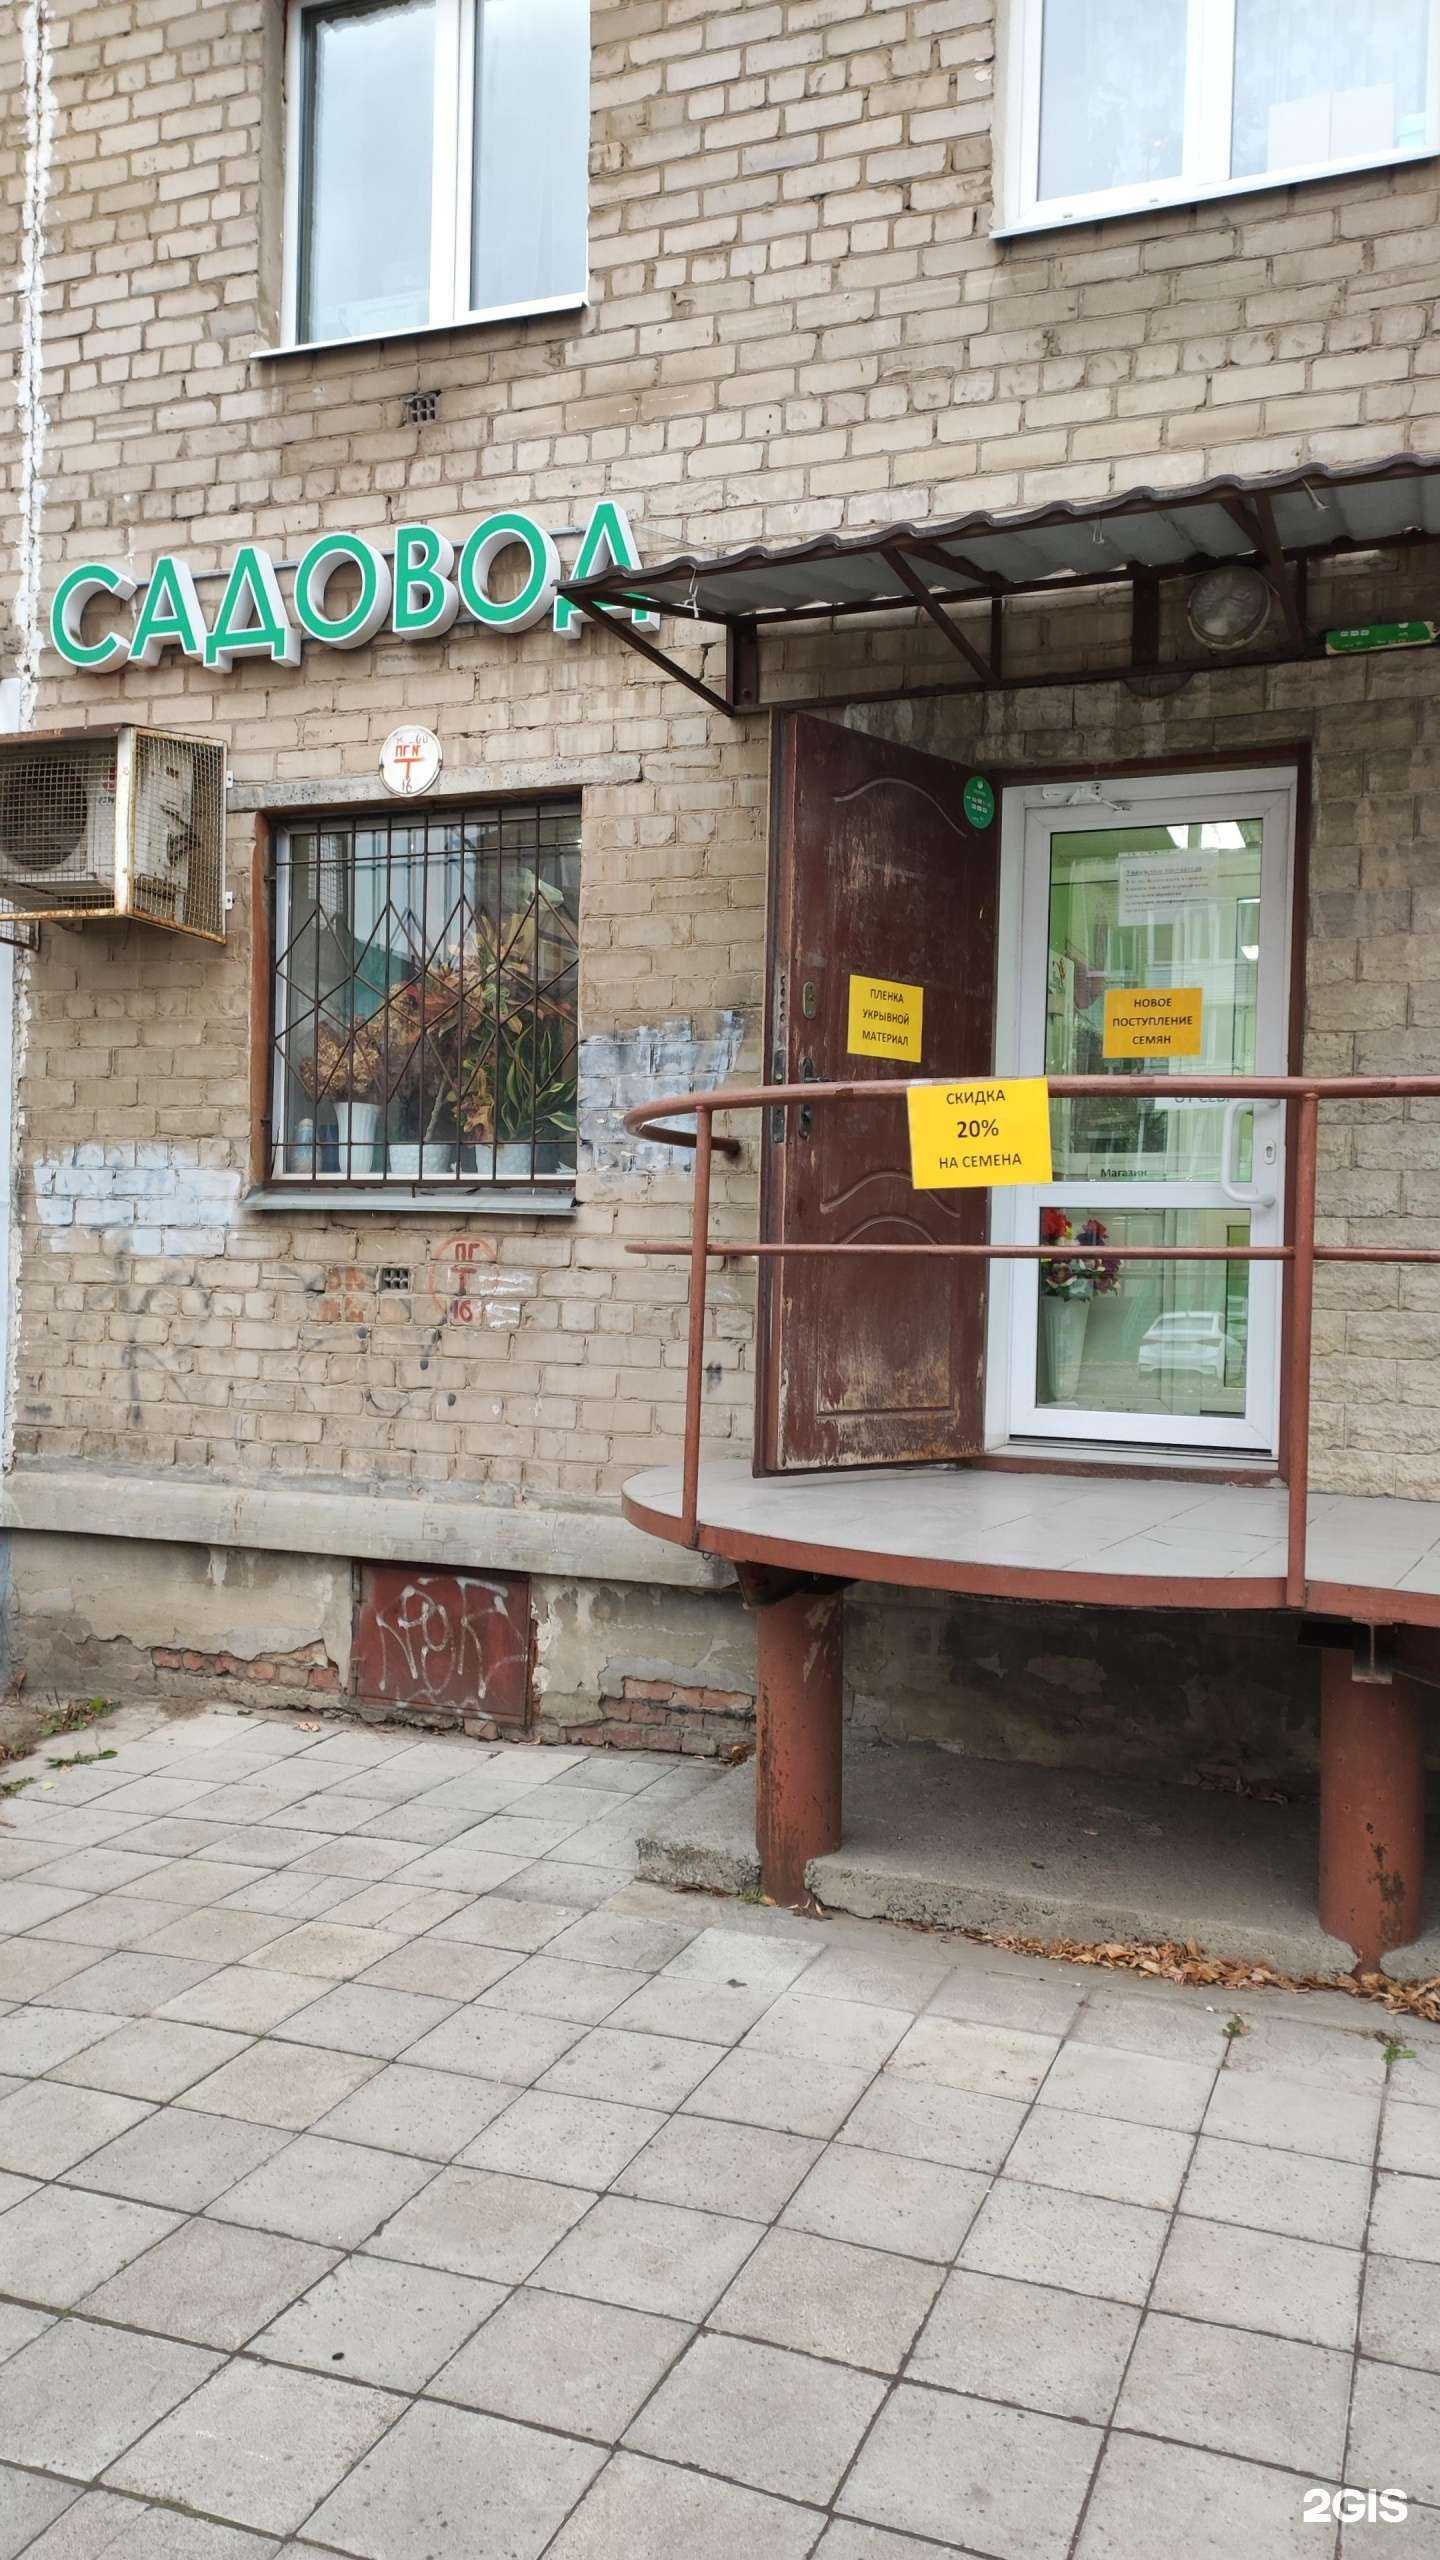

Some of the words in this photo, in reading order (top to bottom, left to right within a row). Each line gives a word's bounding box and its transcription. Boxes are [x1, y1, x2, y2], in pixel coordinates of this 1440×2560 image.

[50, 501, 656, 671] САДОВОД
[870, 988, 904, 1003] ПЛЕНКА
[1134, 998, 1172, 1008] НОВОЕ
[862, 1009, 910, 1025] УКРЫВНОЙ
[1112, 1016, 1193, 1027] ПОСТУПЛЕНИЕ
[862, 1030, 909, 1047] МАТЕРИАЛ
[1132, 1035, 1171, 1045] СЕМЯН
[946, 1089, 1006, 1105] СКИДКА
[957, 1119, 999, 1138] 20%
[939, 1157, 959, 1169] НА
[962, 1153, 1022, 1168] СЕМЕНА
[1100, 1168, 1148, 1177] Магазин
